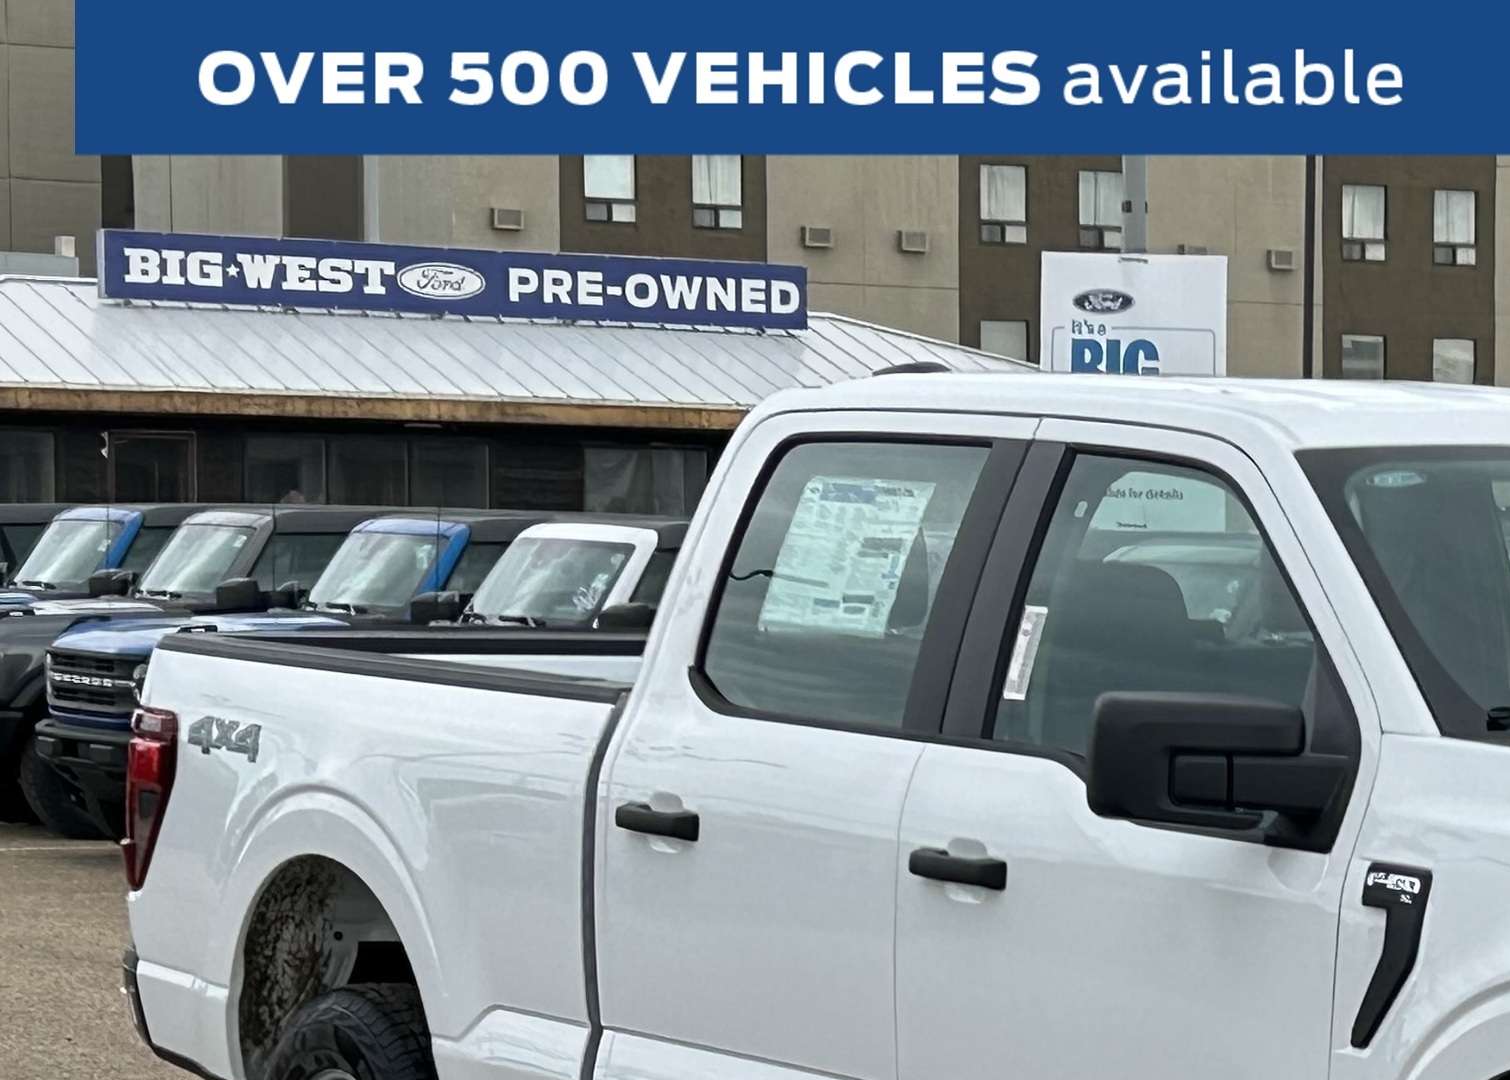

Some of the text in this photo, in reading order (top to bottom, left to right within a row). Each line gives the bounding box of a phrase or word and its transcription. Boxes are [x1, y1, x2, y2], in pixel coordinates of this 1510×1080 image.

[123, 247, 799, 313] BIG WEST Ford PRE-OWNED
[1071, 338, 1160, 376] BIG
